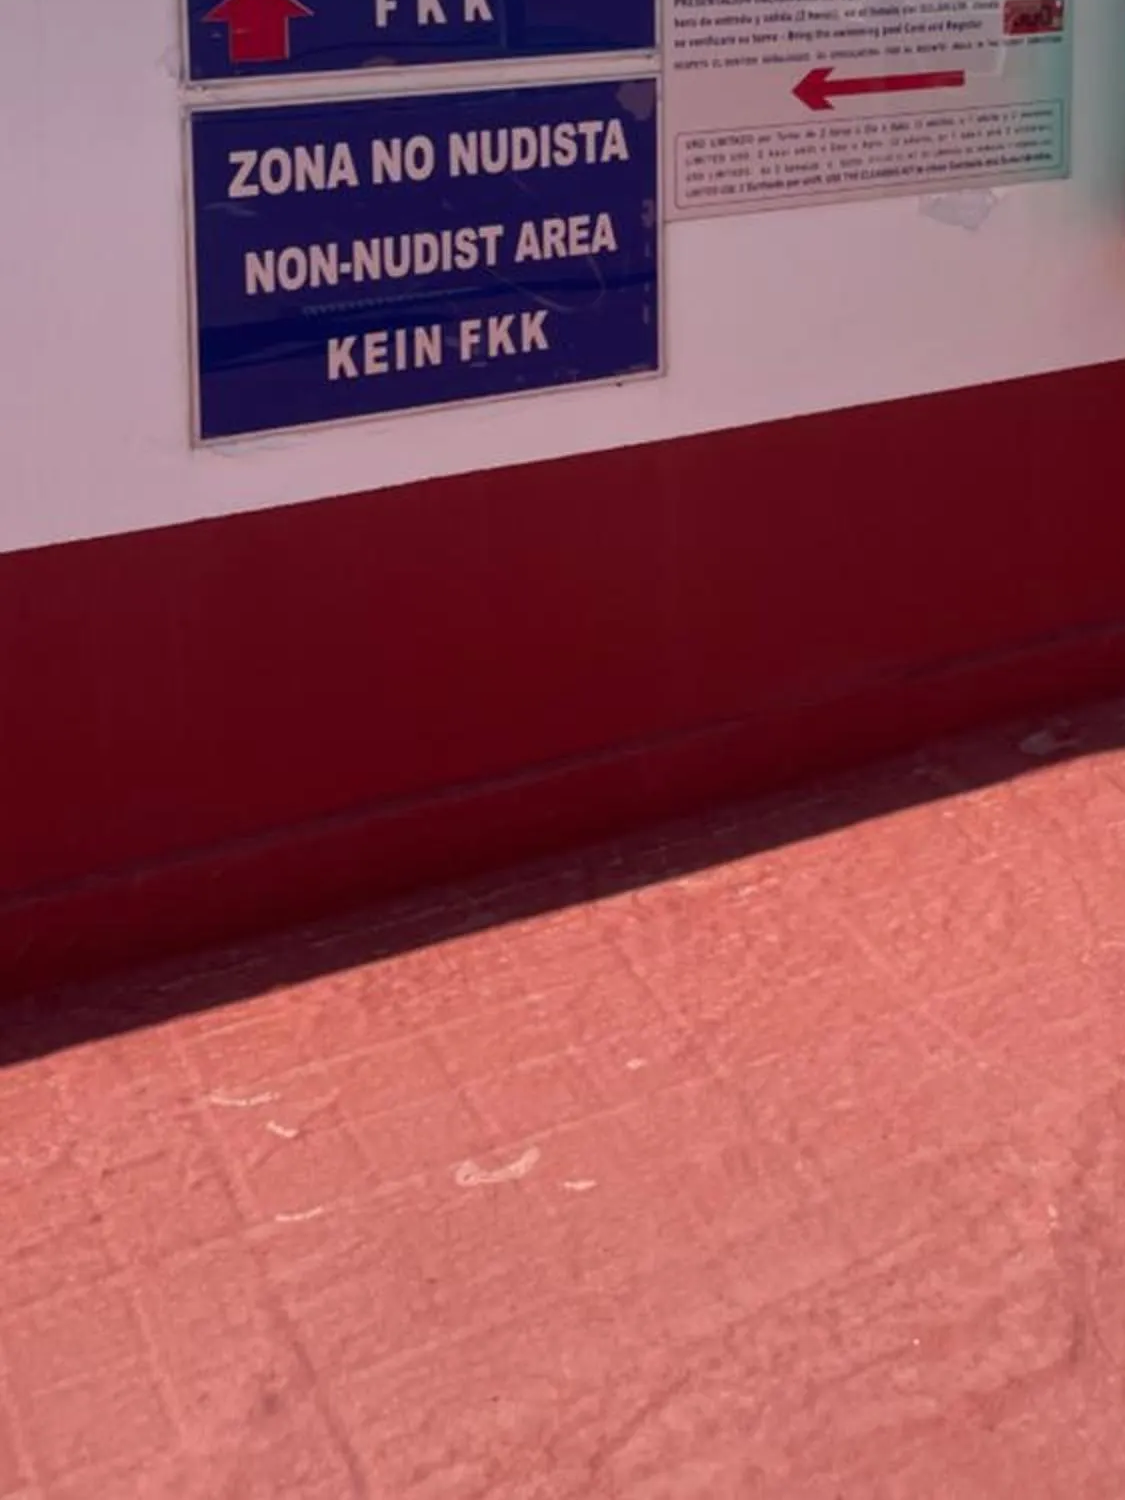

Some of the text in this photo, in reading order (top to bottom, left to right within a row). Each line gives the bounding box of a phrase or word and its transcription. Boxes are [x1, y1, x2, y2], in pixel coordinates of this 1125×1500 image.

[227, 117, 630, 199] ZONA NO NUDISTA
[245, 212, 618, 296] NON-NUDIST AREA
[327, 309, 549, 381] KEIN FKK
